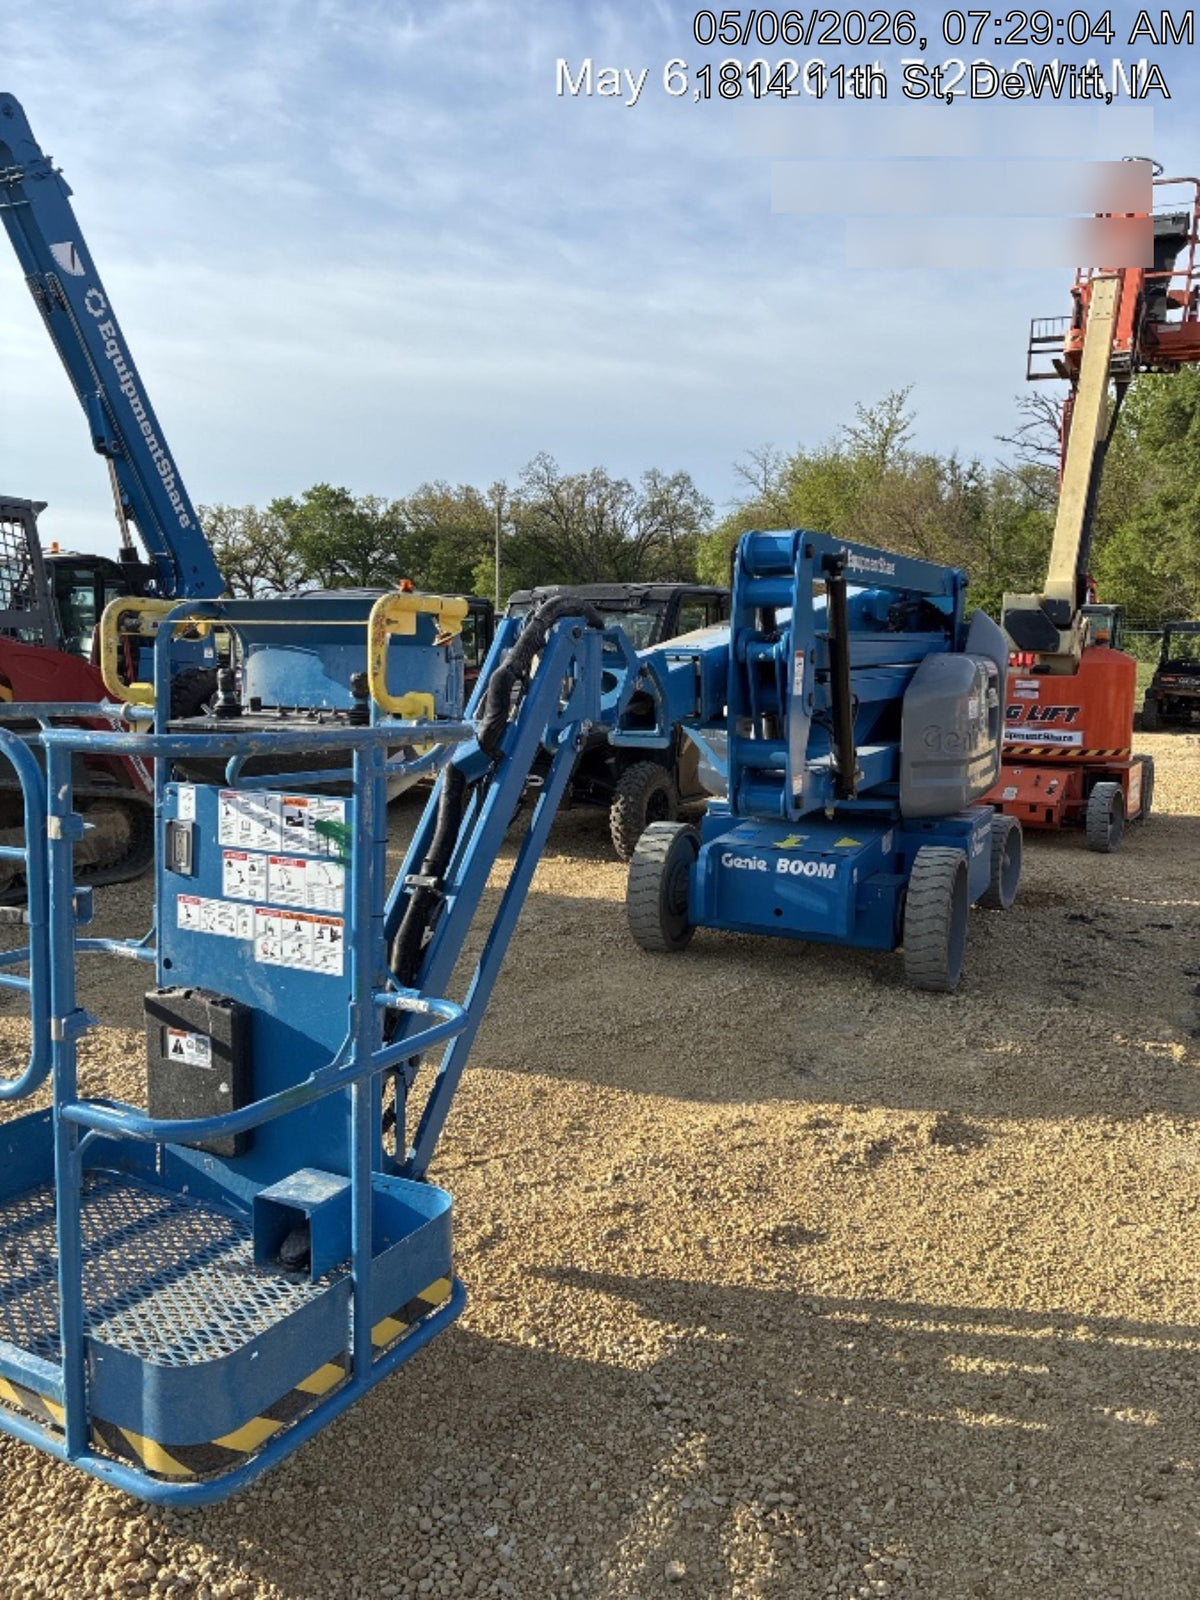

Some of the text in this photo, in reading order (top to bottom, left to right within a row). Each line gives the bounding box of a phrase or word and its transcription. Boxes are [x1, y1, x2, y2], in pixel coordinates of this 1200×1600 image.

[98, 319, 192, 529] EquipmentShare
[1025, 705, 1081, 723] LIFT
[721, 852, 837, 879] Genie BOOM
